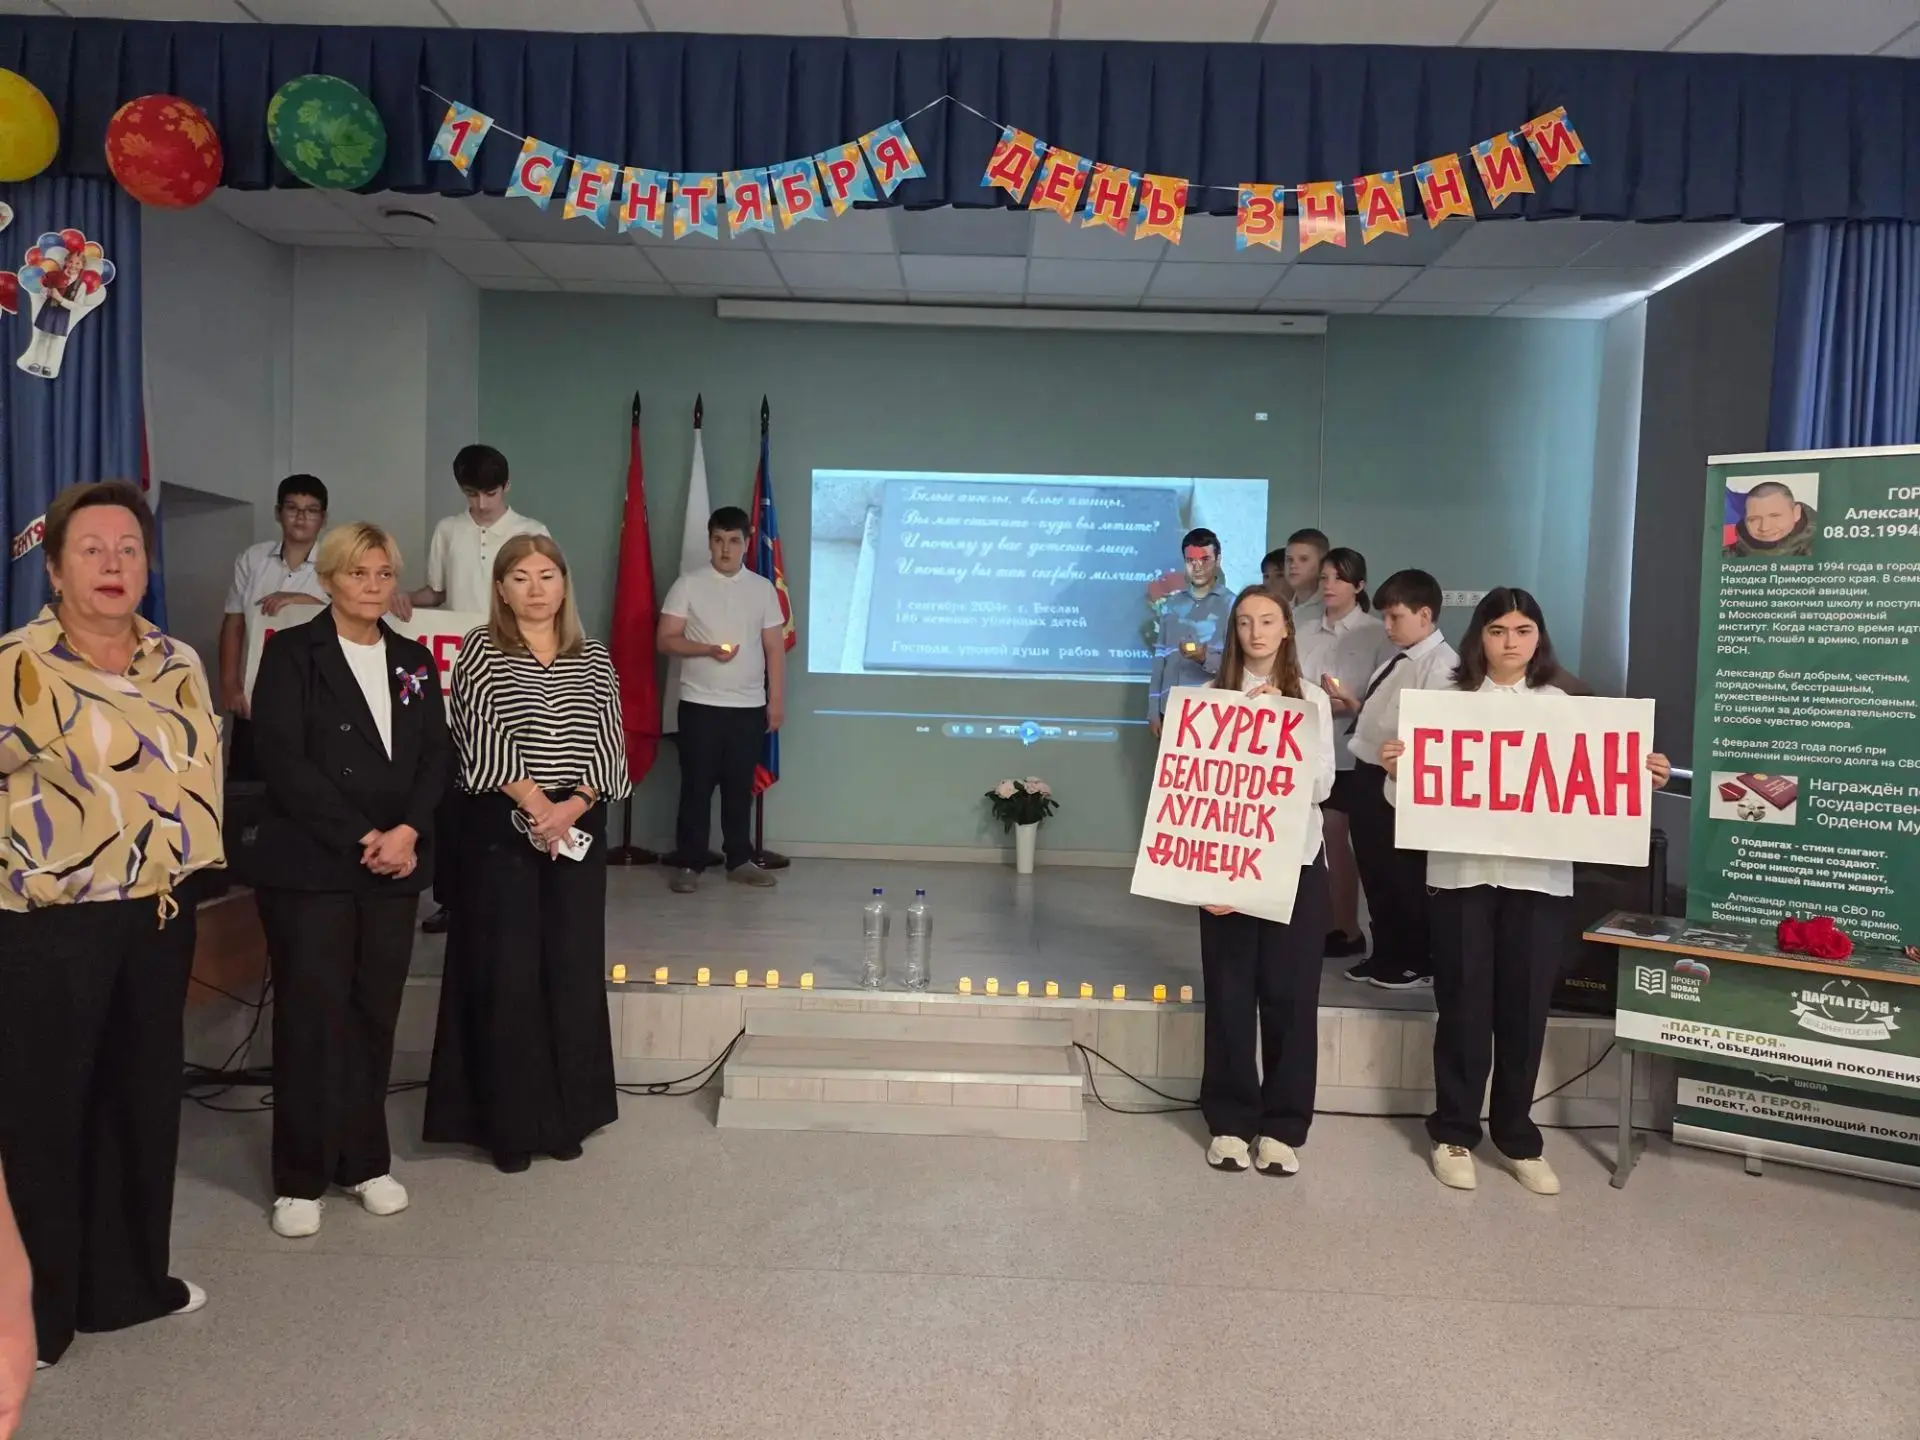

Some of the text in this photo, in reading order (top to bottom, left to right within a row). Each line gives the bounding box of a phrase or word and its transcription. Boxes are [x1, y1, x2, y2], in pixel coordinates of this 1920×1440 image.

[449, 119, 912, 225] 1 СЕНТЯБРЯ
[988, 118, 1580, 237] ДЕНЬ ЗНАНИЙ
[1845, 507, 1920, 521] Алексан
[1721, 563, 1768, 573] Родился
[1770, 562, 1778, 571] 8
[1780, 564, 1814, 573] марта
[1818, 562, 1844, 571] 1994
[1847, 563, 1874, 573] года
[1876, 563, 1883, 571] в
[1720, 575, 1767, 585] Находка
[1769, 573, 1846, 585] Приморского
[1849, 575, 1879, 585] края.
[1882, 574, 1890, 583] В
[1719, 586, 1870, 597] лётчика морской авиации.
[1719, 598, 1768, 608] Успешно
[1770, 599, 1824, 608] закончил
[1826, 599, 1863, 610] школу
[1866, 600, 1873, 608] и
[1719, 610, 1887, 621] в Московский автодорожный
[1718, 623, 1770, 633] институт.
[1772, 622, 1805, 633] Когда
[1808, 624, 1855, 632] настало
[1857, 625, 1895, 634] время
[1717, 634, 1909, 645] служить, пошёл в армию, попал в
[1058, 646, 1100, 660] рабов
[1717, 645, 1751, 654] РВСН.
[1715, 668, 1910, 683] Александр был добрым, честным,
[1715, 681, 1874, 694] порядочным, бесстрашным,
[1714, 693, 1800, 703] мужественным
[1812, 696, 1918, 707] немногословным.
[1714, 703, 1733, 712] Его
[1735, 705, 1775, 714] ценили
[1792, 706, 1917, 719] доброжелательность
[1175, 698, 1305, 761] КУРСК
[1722, 715, 1762, 724] особое
[1764, 718, 1809, 727] чувство
[1811, 720, 1854, 730] юмора.
[1712, 737, 1886, 756] 4 февраля 2023 года погиб при
[1712, 750, 1781, 760] выполнении
[1783, 754, 1841, 764] воинского
[1844, 757, 1879, 766] долга
[1158, 752, 1295, 797] БЕЛГОРОД
[1413, 728, 1642, 816] БЕСЛАН
[1809, 777, 1903, 797] Награждён
[1156, 793, 1277, 843] ЛУГАНСК
[1816, 813, 1893, 831] Орденом
[1146, 831, 1262, 882] ДОНЕЦК
[1731, 836, 1888, 859] О подвигах стихи слагают.
[1729, 859, 1767, 870] «Герои
[1769, 865, 1814, 876] никогда
[1816, 869, 1830, 877] не
[1738, 848, 1880, 870] О славе песни создают.
[1722, 869, 1753, 880] Герои
[1764, 875, 1801, 886] нашей
[1803, 879, 1845, 890] памяти
[1848, 883, 1895, 895] живут!»
[1728, 892, 1886, 918] Александр попал на СВО по
[1711, 902, 1783, 917] мобилизации
[1795, 910, 1800, 919] 1
[1860, 919, 1902, 931] армию.
[1712, 911, 1901, 943] Военная стрелок,
[1671, 975, 1701, 986] ПРОЕКТ
[1671, 983, 1699, 994] НОВАЯ
[1671, 991, 1701, 1002] ШКОЛА
[1801, 989, 1890, 1014] ПАРТА ГЕРОЯ
[1662, 1021, 1786, 1048] «ПАРТА ГЕРОЯ»
[1660, 1032, 1713, 1049] ПРОЕКТ,
[1716, 1041, 1833, 1069] ОБЪЕДИНЯЮЩИЙ
[1794, 1080, 1828, 1092] ШКОЛА
[1697, 1085, 1820, 1113] «ПАРТА ГЕРОЯ»
[1696, 1096, 1920, 1142] ПРОЕКТ, ОБЪЕДИНЯЮЩИЙ ПОКОЛ
